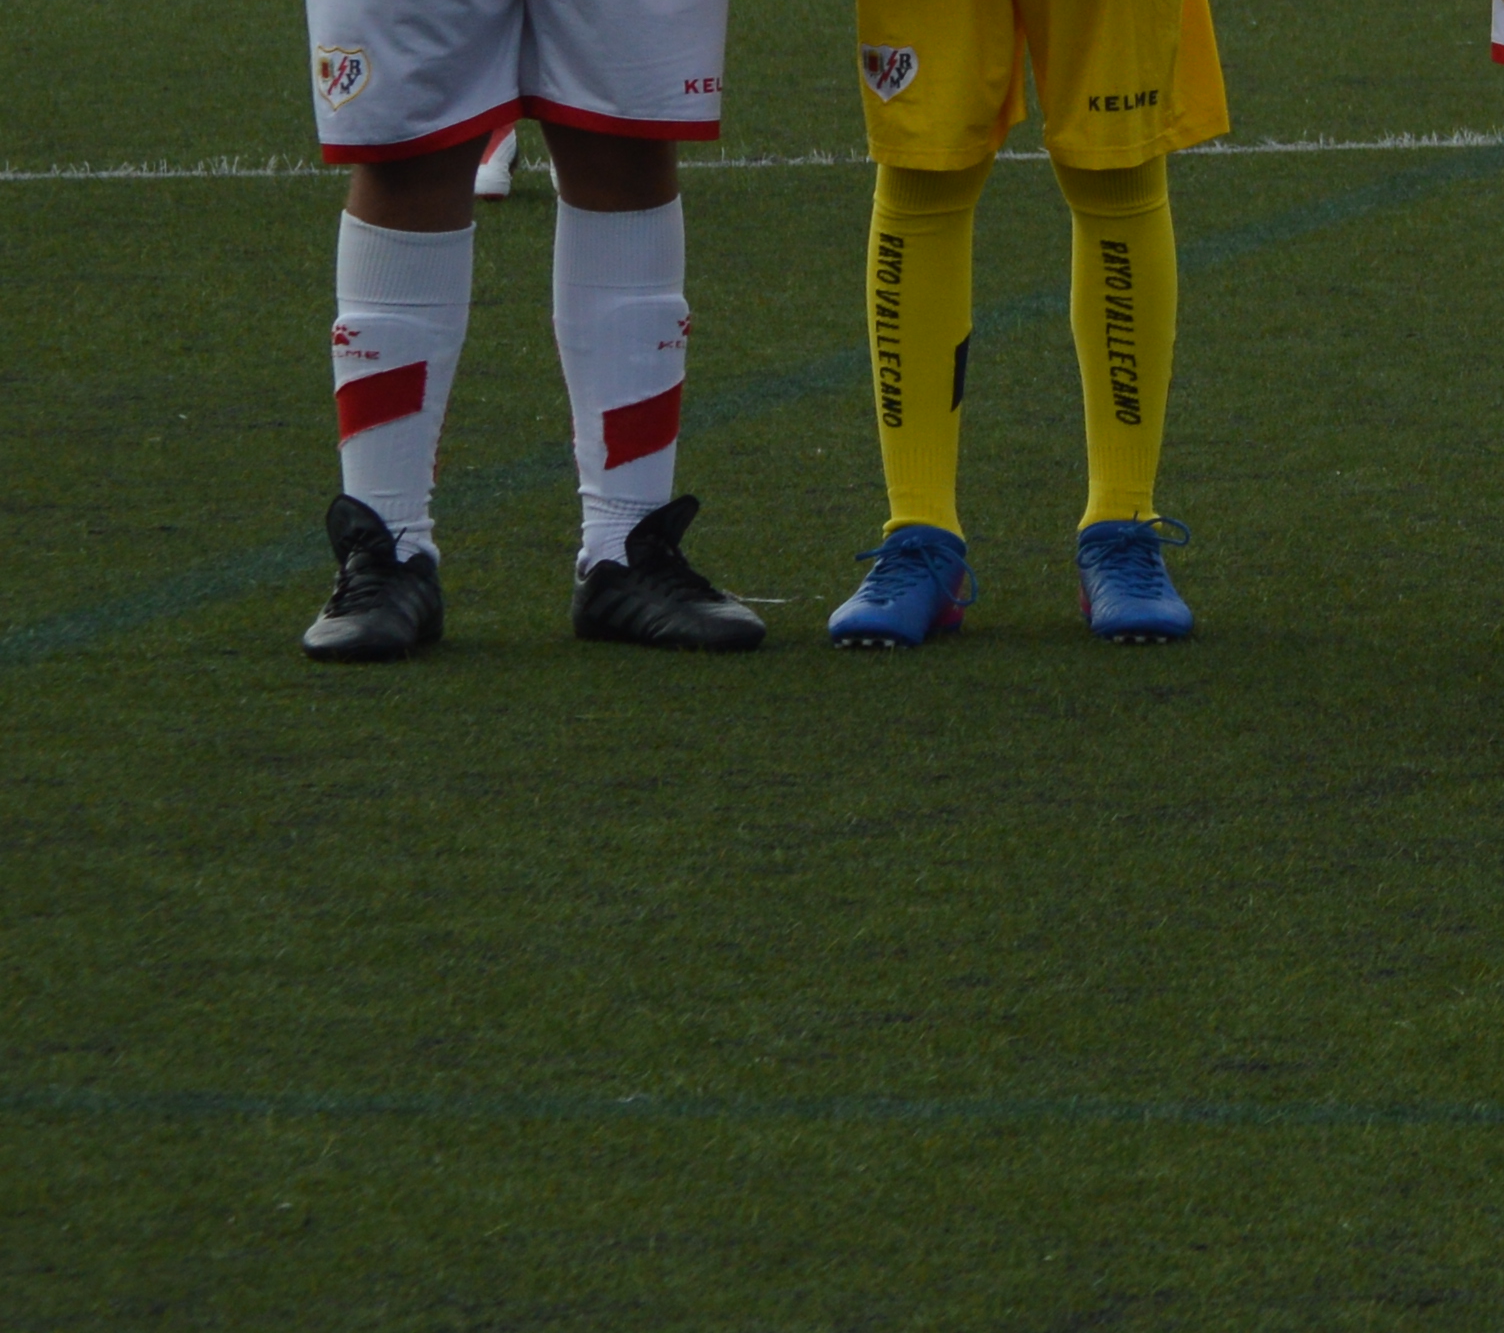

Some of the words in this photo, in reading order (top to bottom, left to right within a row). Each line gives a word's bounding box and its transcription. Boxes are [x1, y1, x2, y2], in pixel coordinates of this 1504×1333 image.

[1088, 89, 1159, 112] KELME
[876, 232, 904, 285] RAYO
[1099, 239, 1132, 292] RAYO
[875, 289, 903, 429] VALLECANO
[1105, 295, 1142, 427] VALLECANO
